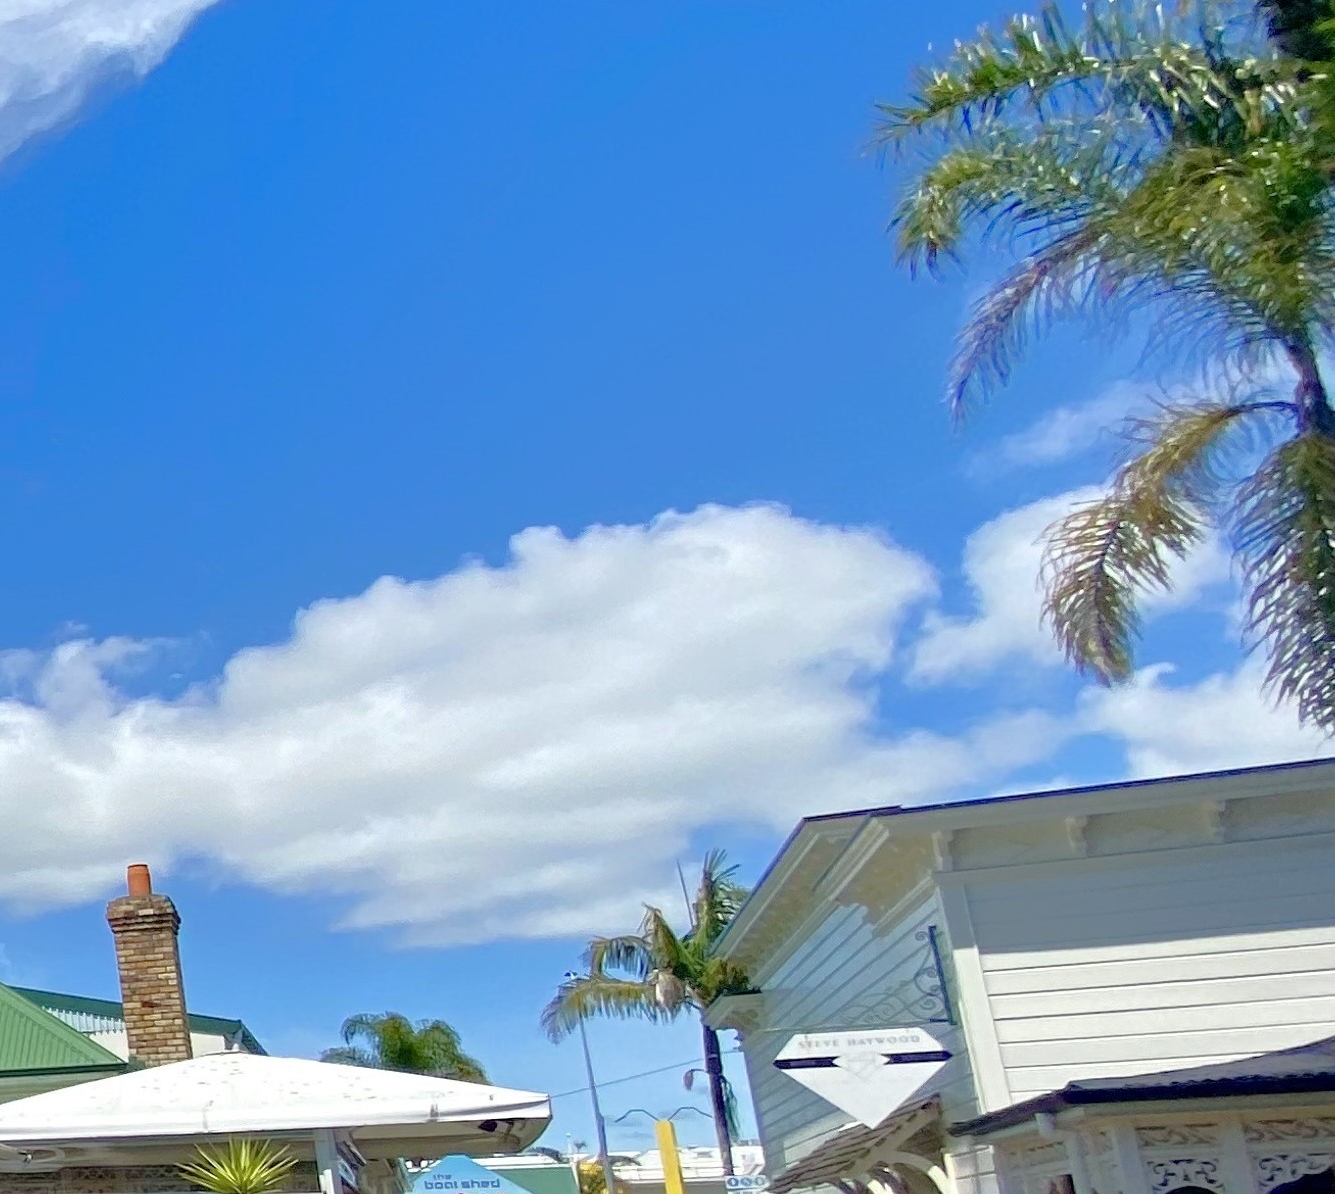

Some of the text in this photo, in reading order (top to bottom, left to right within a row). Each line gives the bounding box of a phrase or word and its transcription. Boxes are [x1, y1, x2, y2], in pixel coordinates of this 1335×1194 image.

[798, 1035, 921, 1049] STEVE HAYWOOD
[424, 1178, 501, 1190] boat shed
